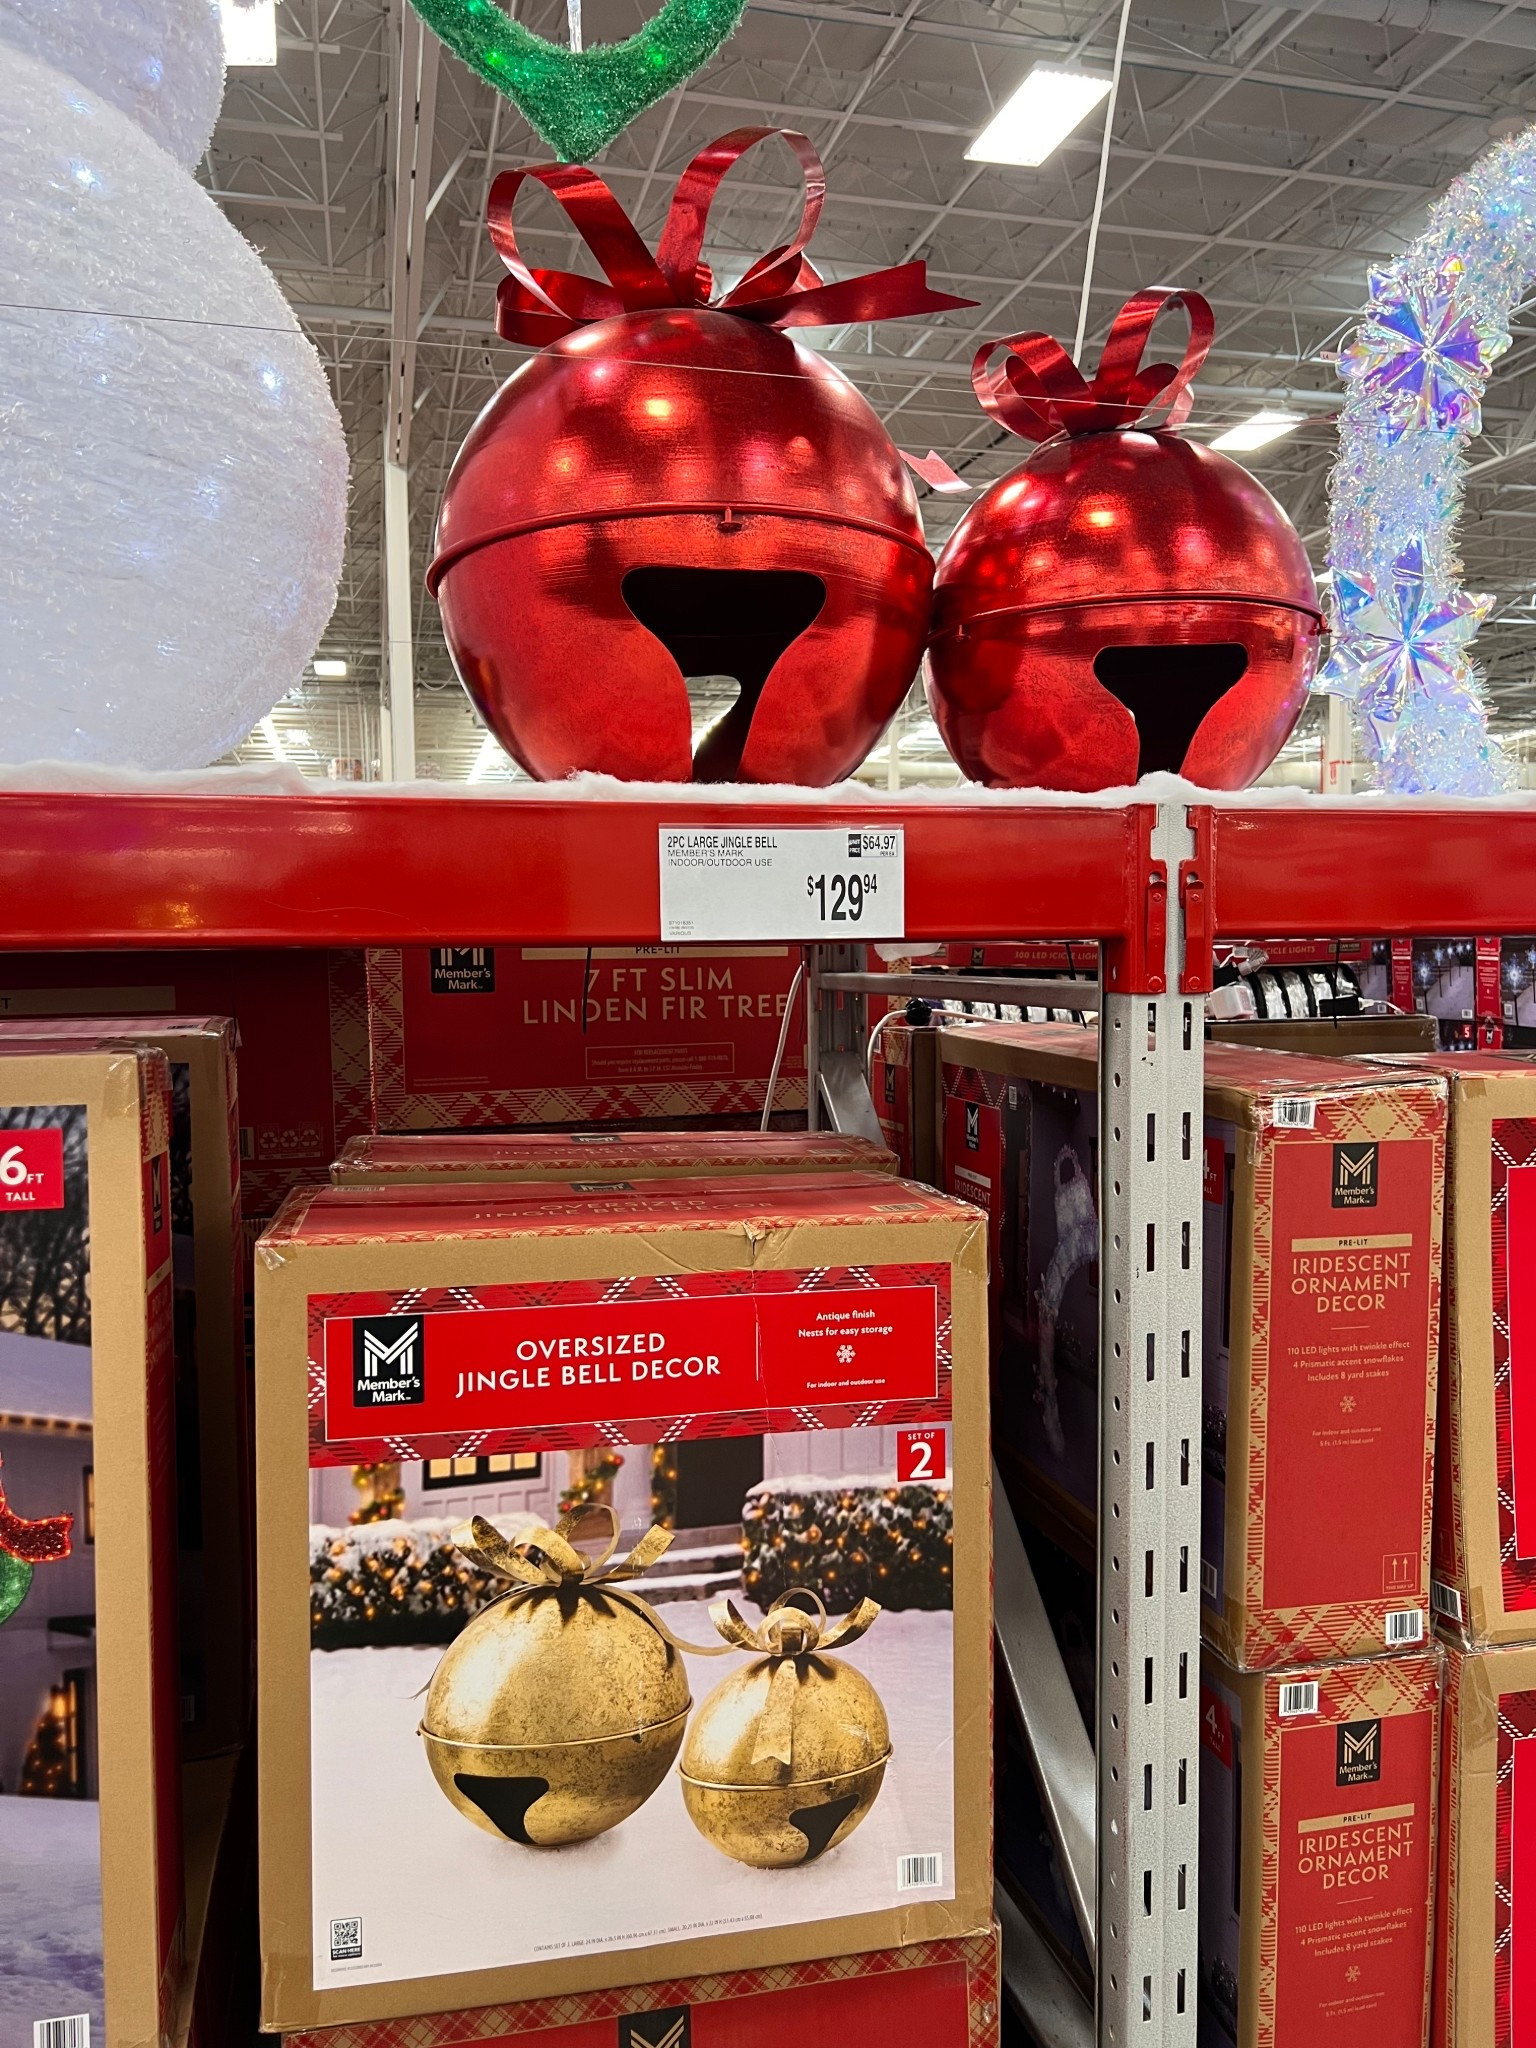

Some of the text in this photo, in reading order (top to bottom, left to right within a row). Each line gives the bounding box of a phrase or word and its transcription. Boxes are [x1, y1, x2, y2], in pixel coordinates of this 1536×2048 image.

[667, 836, 778, 848] 2PC LARGE JINGLE BELL
[863, 834, 896, 851] $64.97
[668, 849, 744, 857] MEMBER'S MARK
[668, 858, 773, 867] INDOOR/OUTDOOR USE
[1014, 951, 1029, 959] 300
[1032, 951, 1047, 959] LED
[1266, 946, 1315, 955] CICLE LIGHTS
[435, 968, 491, 980] Member's
[612, 968, 647, 992] FT
[660, 967, 733, 991] SLIM
[523, 994, 788, 1024] LINDEN FIR TREE
[0, 1145, 44, 1186] 6 FT
[5, 1191, 36, 1201] TALL
[955, 1179, 991, 1203] IRIDESCENT
[1335, 1186, 1375, 1196] Member's
[1338, 1238, 1368, 1247] PRE-LIT
[1292, 1253, 1411, 1275] IRIDESCENT
[1291, 1272, 1411, 1295] ORNAMENT
[1317, 1293, 1386, 1313] DECOR
[816, 1309, 876, 1322] Antique finish
[798, 1325, 893, 1338] Nests for easy storage
[516, 1332, 665, 1361] OVERSIZED
[1287, 1340, 1410, 1356] 110 LED lights with twinkle effect
[1300, 1359, 1335, 1368] Prismatic
[1336, 1358, 1361, 1366] accent
[1363, 1355, 1404, 1365] snowflakes
[357, 1375, 421, 1391] Member's
[455, 1355, 721, 1399] JINGLE BELL DECOR
[818, 1380, 838, 1388] indoor
[838, 1379, 849, 1387] and
[1307, 1372, 1339, 1382] Includes
[1347, 1370, 1364, 1381] yard
[1365, 1369, 1390, 1378] stakes
[907, 1432, 922, 1441] SET
[909, 1441, 933, 1479] 2
[1206, 1705, 1217, 1734] 4
[1339, 1762, 1378, 1774] Member's
[1343, 1812, 1372, 1823] PRE-LIT
[1299, 1822, 1414, 1855] IRIDESCENT
[1298, 1840, 1414, 1874] ORNAMENT
[1323, 1864, 1389, 1890] DECOR
[1295, 1906, 1413, 1934] 110 LED lights with twinkle effect
[1300, 1920, 1407, 1946] 4 Prismatic accent snowflakes
[1314, 1945, 1344, 1957] Includes
[1352, 1940, 1368, 1953] yard
[1370, 1936, 1393, 1947] stakes
